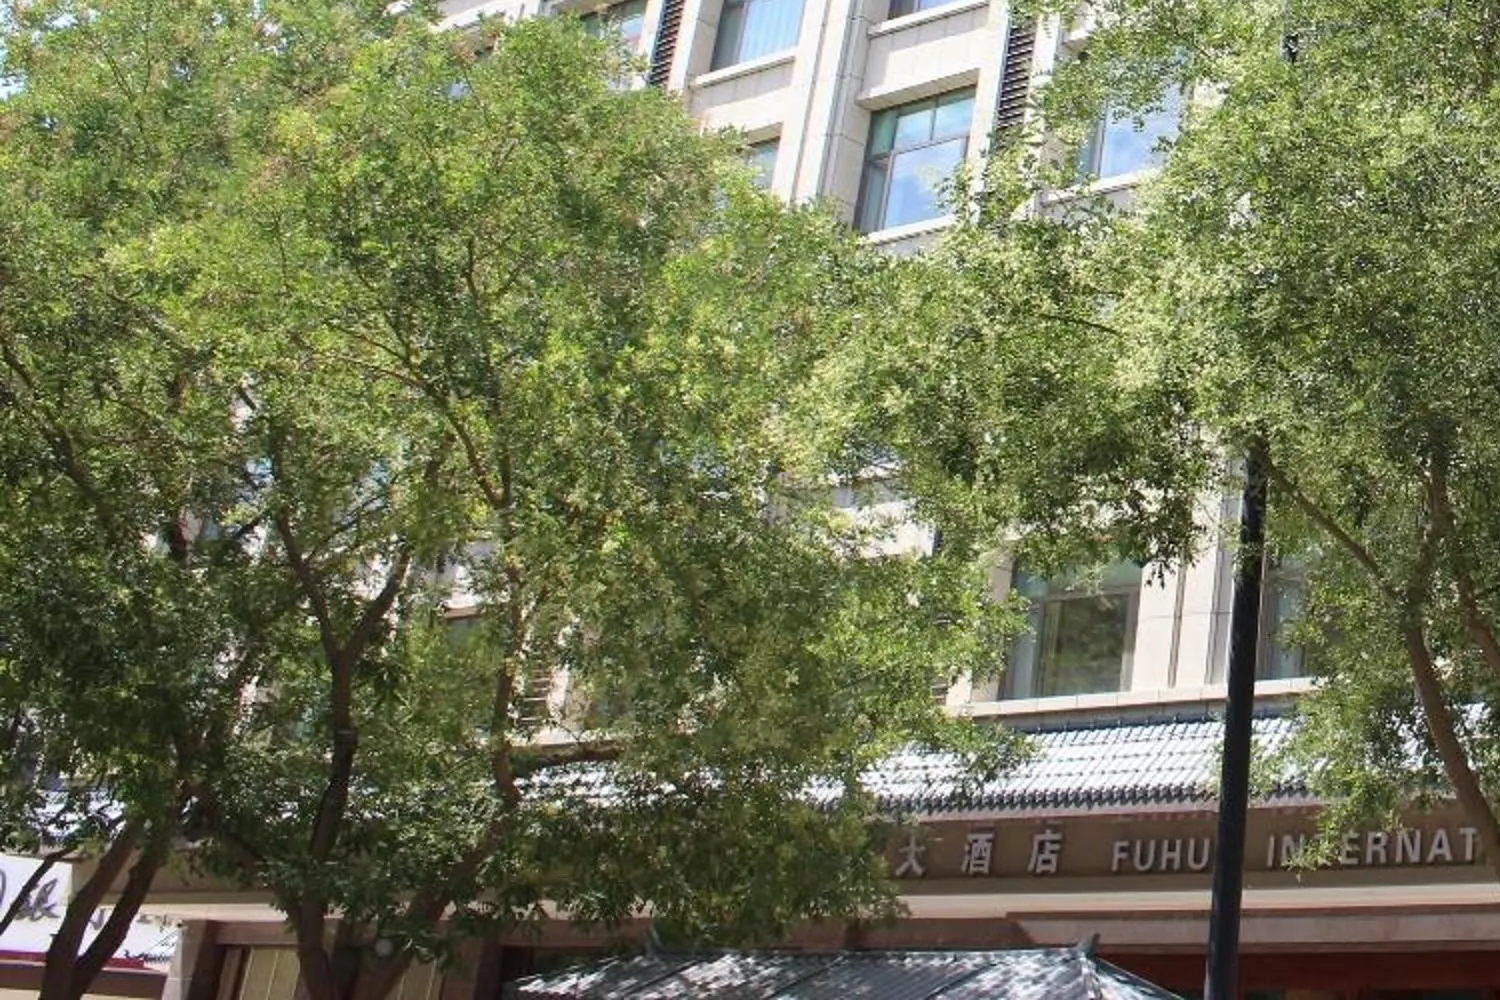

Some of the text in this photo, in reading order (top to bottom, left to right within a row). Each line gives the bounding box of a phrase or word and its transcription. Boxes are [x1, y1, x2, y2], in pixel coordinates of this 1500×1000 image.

[895, 831, 1062, 876] 大酒店
[1110, 836, 1213, 872] FUHU
